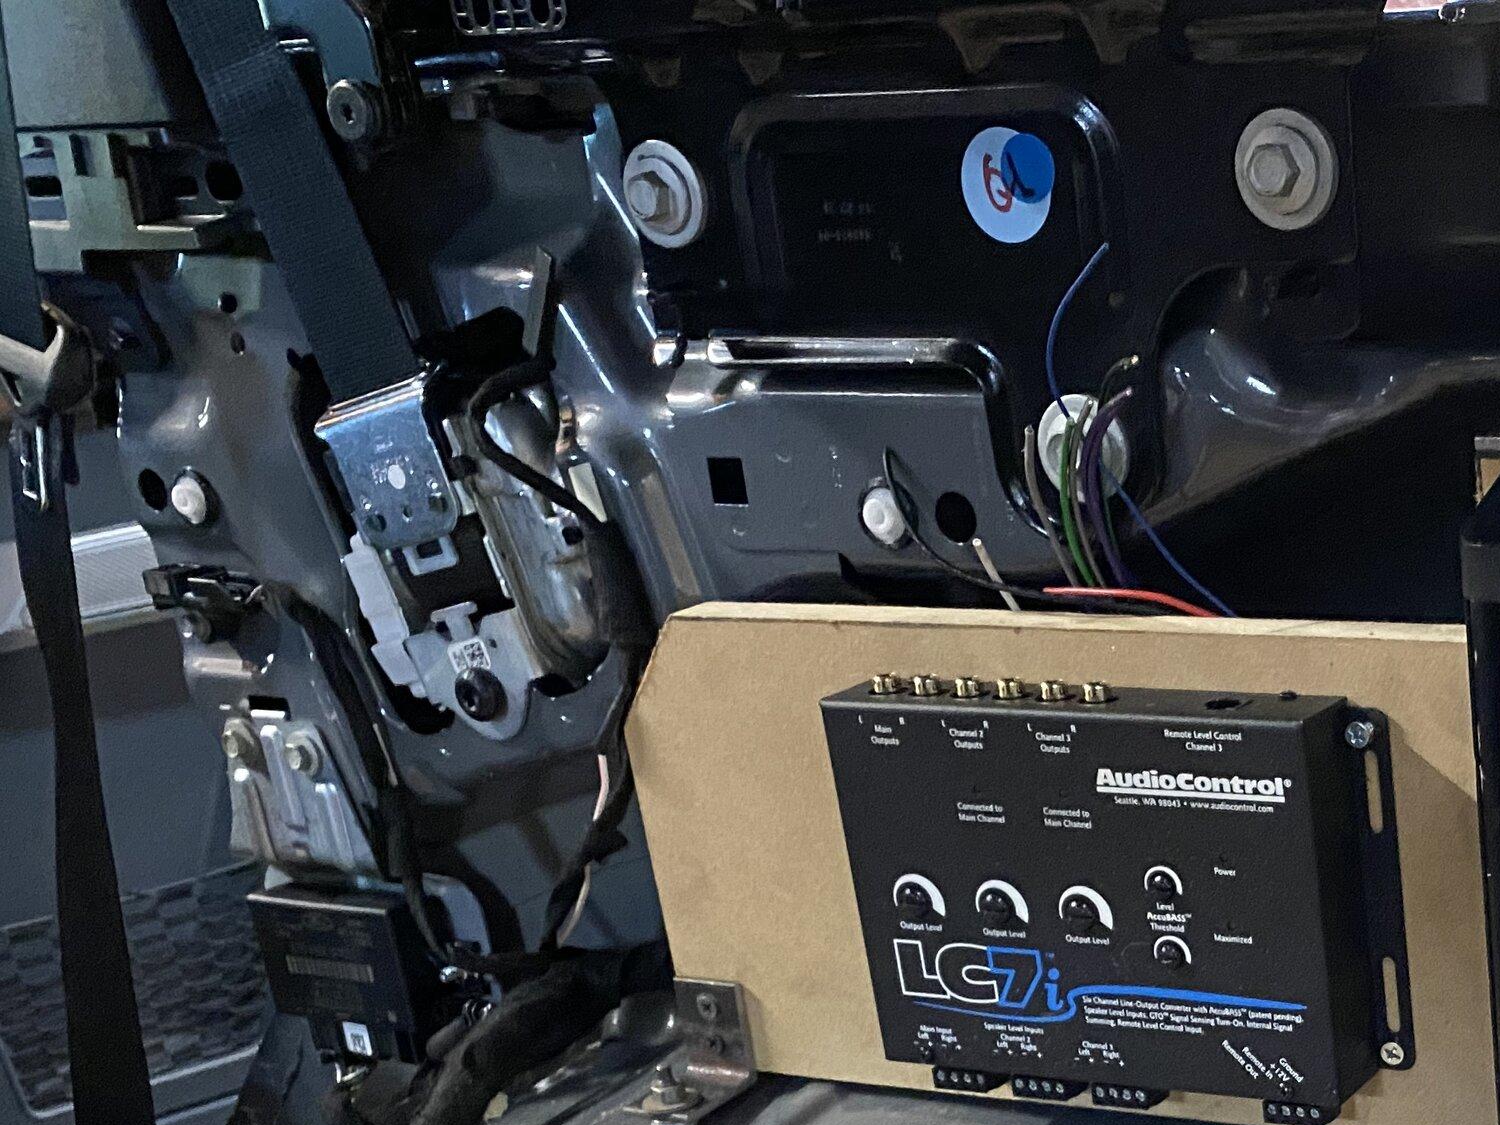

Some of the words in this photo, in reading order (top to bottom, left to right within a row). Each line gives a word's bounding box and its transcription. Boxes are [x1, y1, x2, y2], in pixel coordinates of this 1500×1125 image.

[874, 724, 892, 734] Main
[949, 728, 977, 738] Channel
[871, 735, 900, 746] Outputs
[1035, 732, 1064, 742] Channel
[1164, 729, 1192, 740] Remote
[1194, 730, 1212, 740] Level
[1214, 731, 1242, 741] Control
[954, 740, 983, 750] Outputs
[1040, 743, 1070, 754] Outputs
[1186, 742, 1216, 752] Channel
[957, 802, 994, 812] Connected
[995, 804, 1003, 813] to
[1114, 796, 1140, 806] Seattle,
[1142, 797, 1156, 806] WA
[1158, 798, 1181, 808] 98043
[1190, 800, 1274, 813] www.audiocontrol.com
[958, 812, 976, 822] Main
[977, 814, 1005, 824] Channel
[1043, 807, 1080, 818] Connected
[1081, 809, 1090, 818] to
[1044, 817, 1062, 828] Main
[1063, 819, 1092, 830] Channel
[1214, 866, 1236, 877] Power
[1156, 903, 1174, 911] Level
[900, 921, 924, 932] Output
[925, 923, 943, 932] Level
[1150, 922, 1185, 933] Threshold
[982, 927, 1006, 938] Output
[1008, 930, 1026, 939] Level
[1065, 934, 1091, 945] Output
[1093, 936, 1110, 945] Level
[1214, 933, 1252, 945] Maximized
[1082, 995, 1091, 1003] Six
[1093, 996, 1118, 1006] Channel
[1120, 1000, 1159, 1010] Line-Output
[1160, 1002, 1191, 1012] Converter
[1193, 1006, 1207, 1014] with
[1248, 1010, 1272, 1019] (patent
[1083, 1006, 1107, 1015] Speaker
[1109, 1008, 1125, 1017] Level
[1170, 1013, 1189, 1023] Signal
[1190, 1015, 1215, 1026] Sensing
[1246, 1021, 1271, 1029] Internal
[1272, 1023, 1293, 1032] Signal
[920, 1025, 935, 1033] Main
[936, 1026, 952, 1035] Input
[983, 1022, 1006, 1031] Speaker
[1008, 1024, 1023, 1032] Level
[1024, 1025, 1044, 1035] Inputs
[1117, 1019, 1140, 1028] Remote
[1142, 1021, 1158, 1030] Level
[1159, 1022, 1184, 1032] Control
[917, 1032, 929, 1040] Left
[941, 1034, 957, 1043] Right
[1000, 1033, 1025, 1042] Channel
[996, 1040, 1008, 1048] Left
[1020, 1042, 1037, 1052] Right
[1082, 1041, 1108, 1050] Channel
[1078, 1047, 1090, 1056] Left
[1102, 1050, 1120, 1060] Right
[1222, 1040, 1245, 1066] Remote
[1245, 1064, 1259, 1079] Out
[1242, 1047, 1266, 1072] Remote
[1265, 1070, 1274, 1080] In
[1270, 1063, 1290, 1082] +12V
[1279, 1058, 1304, 1083] Ground
